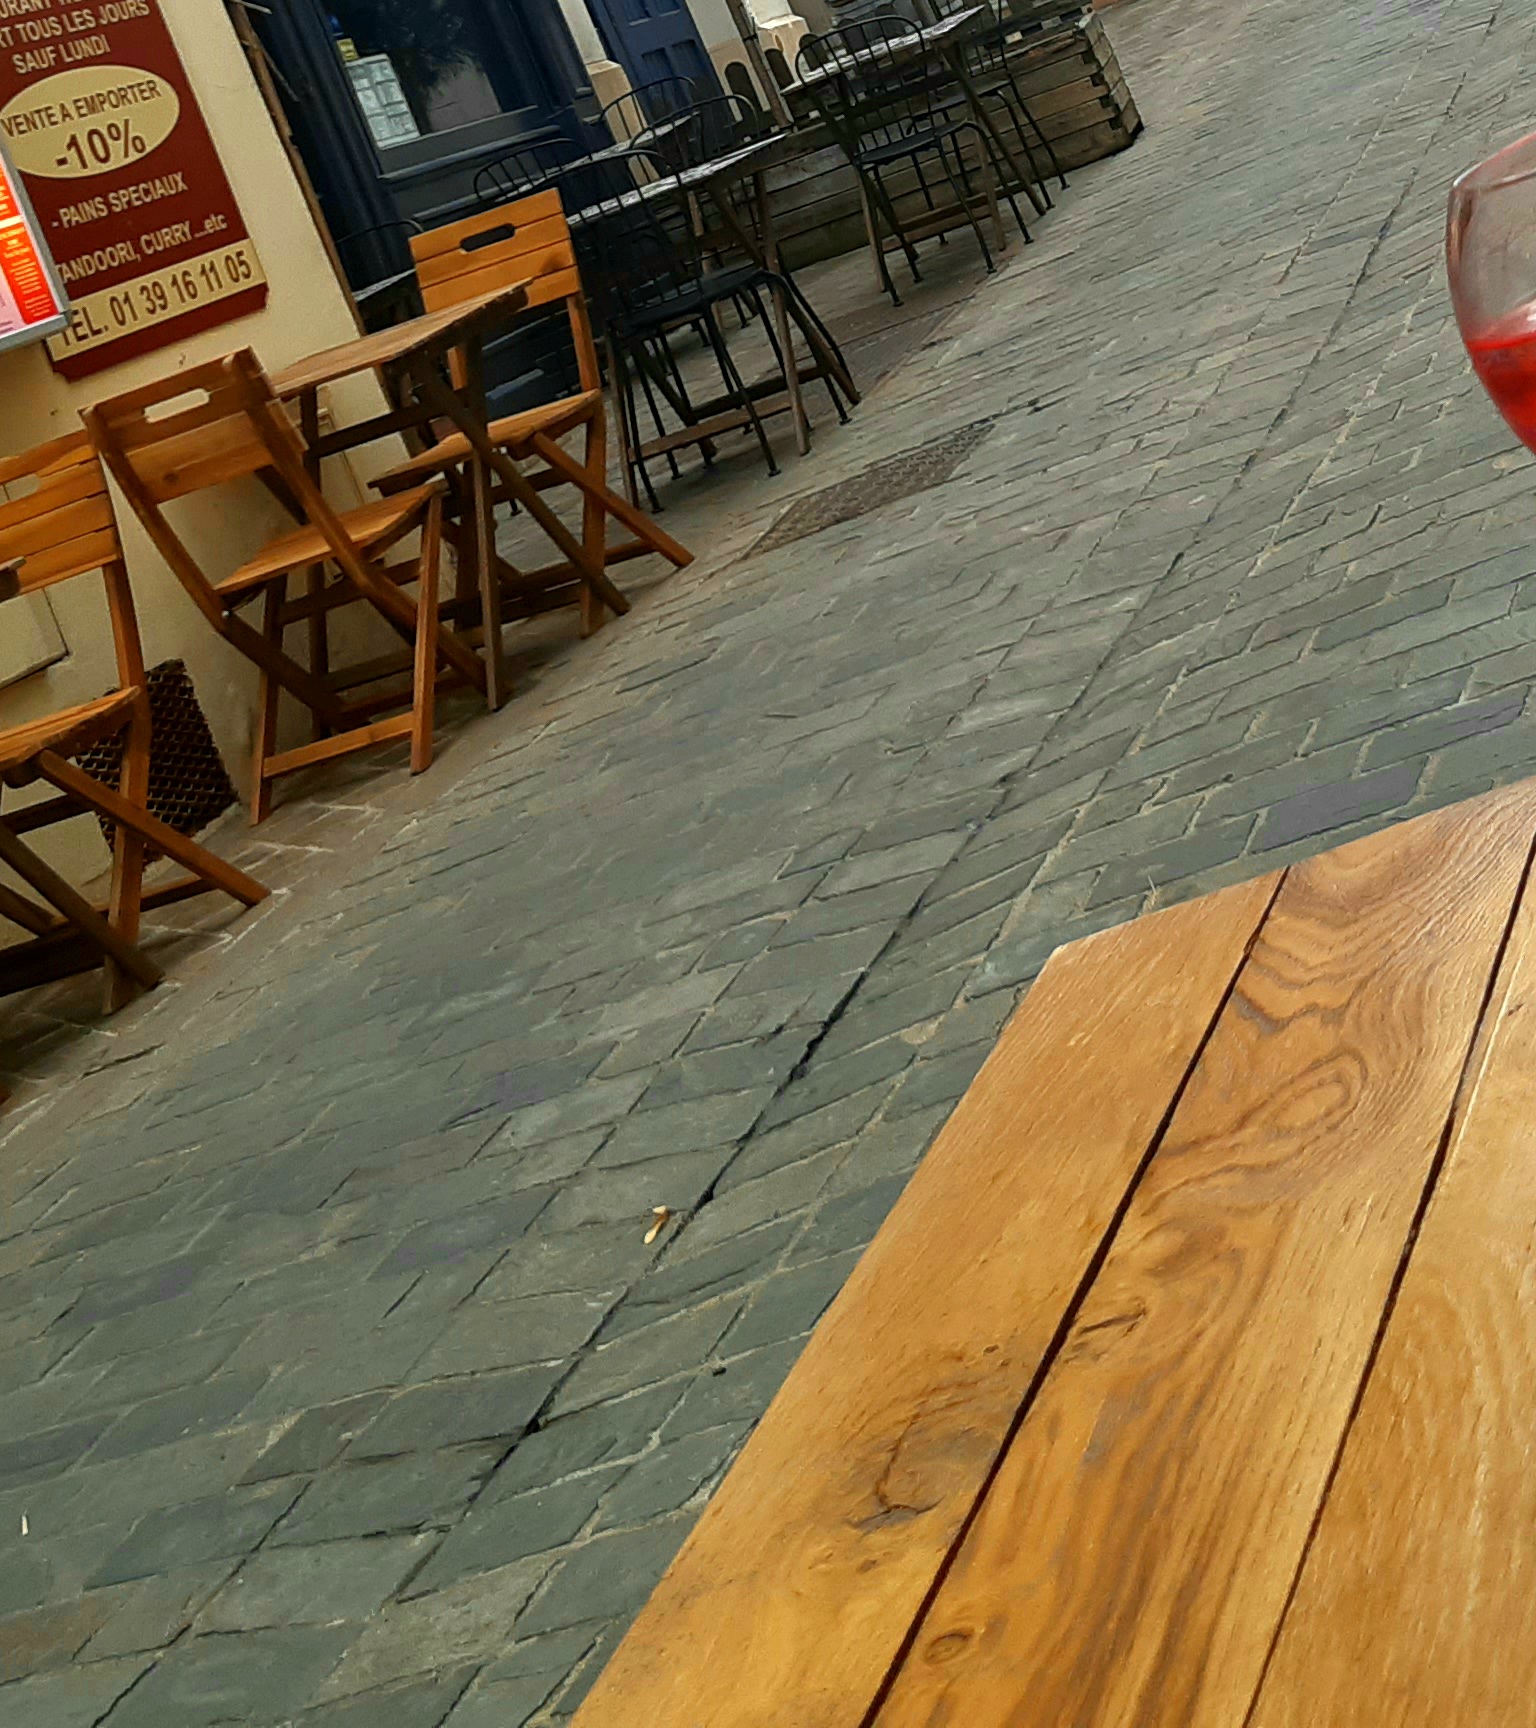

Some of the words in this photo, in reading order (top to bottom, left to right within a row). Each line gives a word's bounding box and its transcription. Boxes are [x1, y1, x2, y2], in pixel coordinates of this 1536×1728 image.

[11, 45, 58, 74] SAUF
[58, 33, 111, 63] LUNDI
[14, 15, 63, 44] TOUS
[63, 8, 97, 34] LES
[0, 102, 60, 138] VENTE
[60, 102, 75, 123] A
[74, 79, 162, 119] EMPORTER
[55, 118, 147, 170] -10%
[59, 198, 109, 229] PAINS
[109, 171, 189, 214] SPECIAUX
[109, 290, 139, 327] 01
[139, 279, 169, 316] 39
[170, 269, 199, 305] 16
[199, 259, 224, 293] 11
[224, 249, 253, 284] 05
